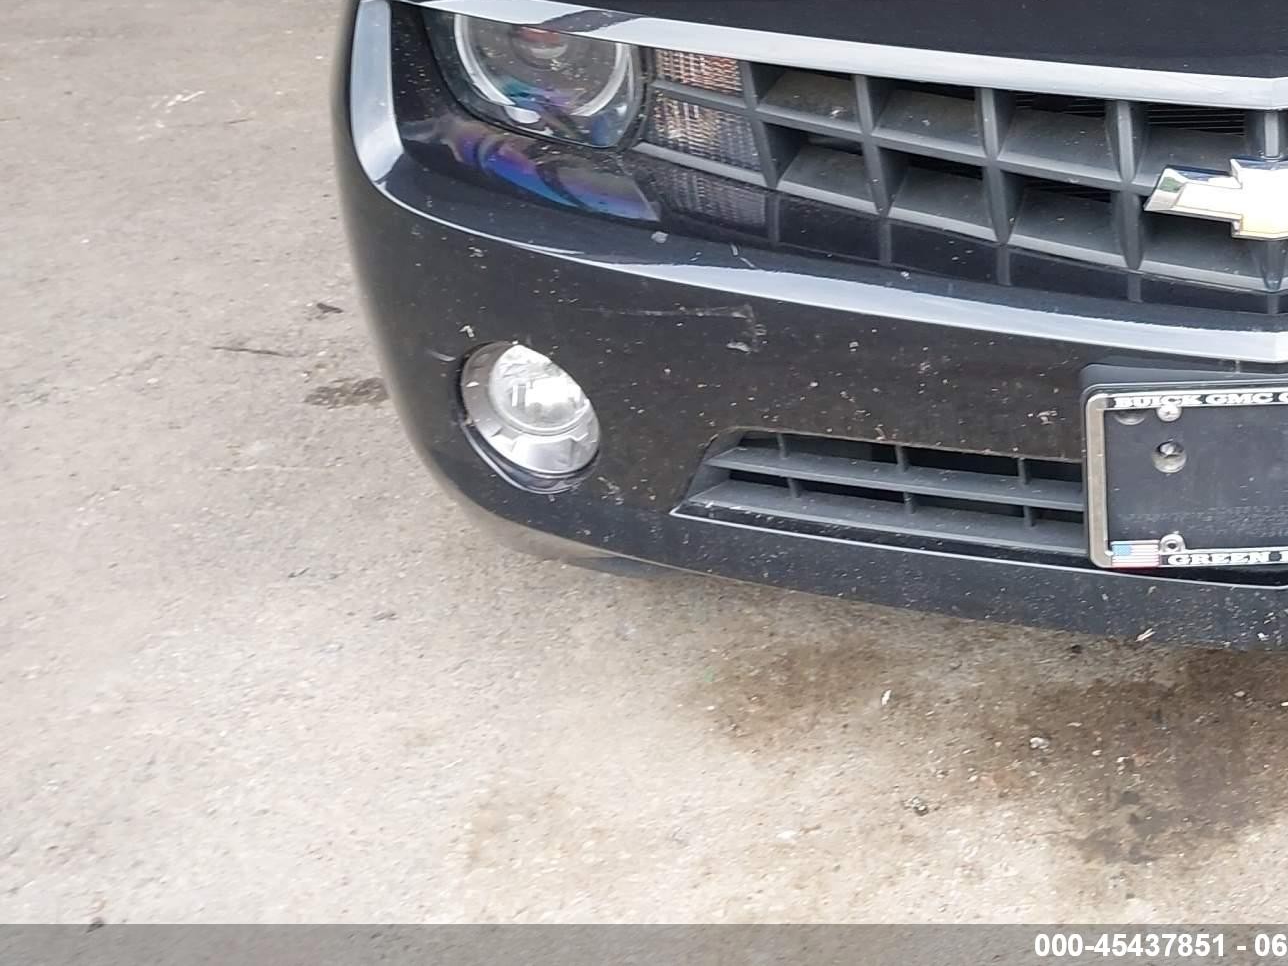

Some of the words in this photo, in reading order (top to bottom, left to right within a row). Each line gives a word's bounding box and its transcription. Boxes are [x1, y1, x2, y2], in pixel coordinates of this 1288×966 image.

[1113, 394, 1203, 409] BUICK
[1206, 392, 1274, 406] GMC
[1168, 552, 1270, 565] GREEN
